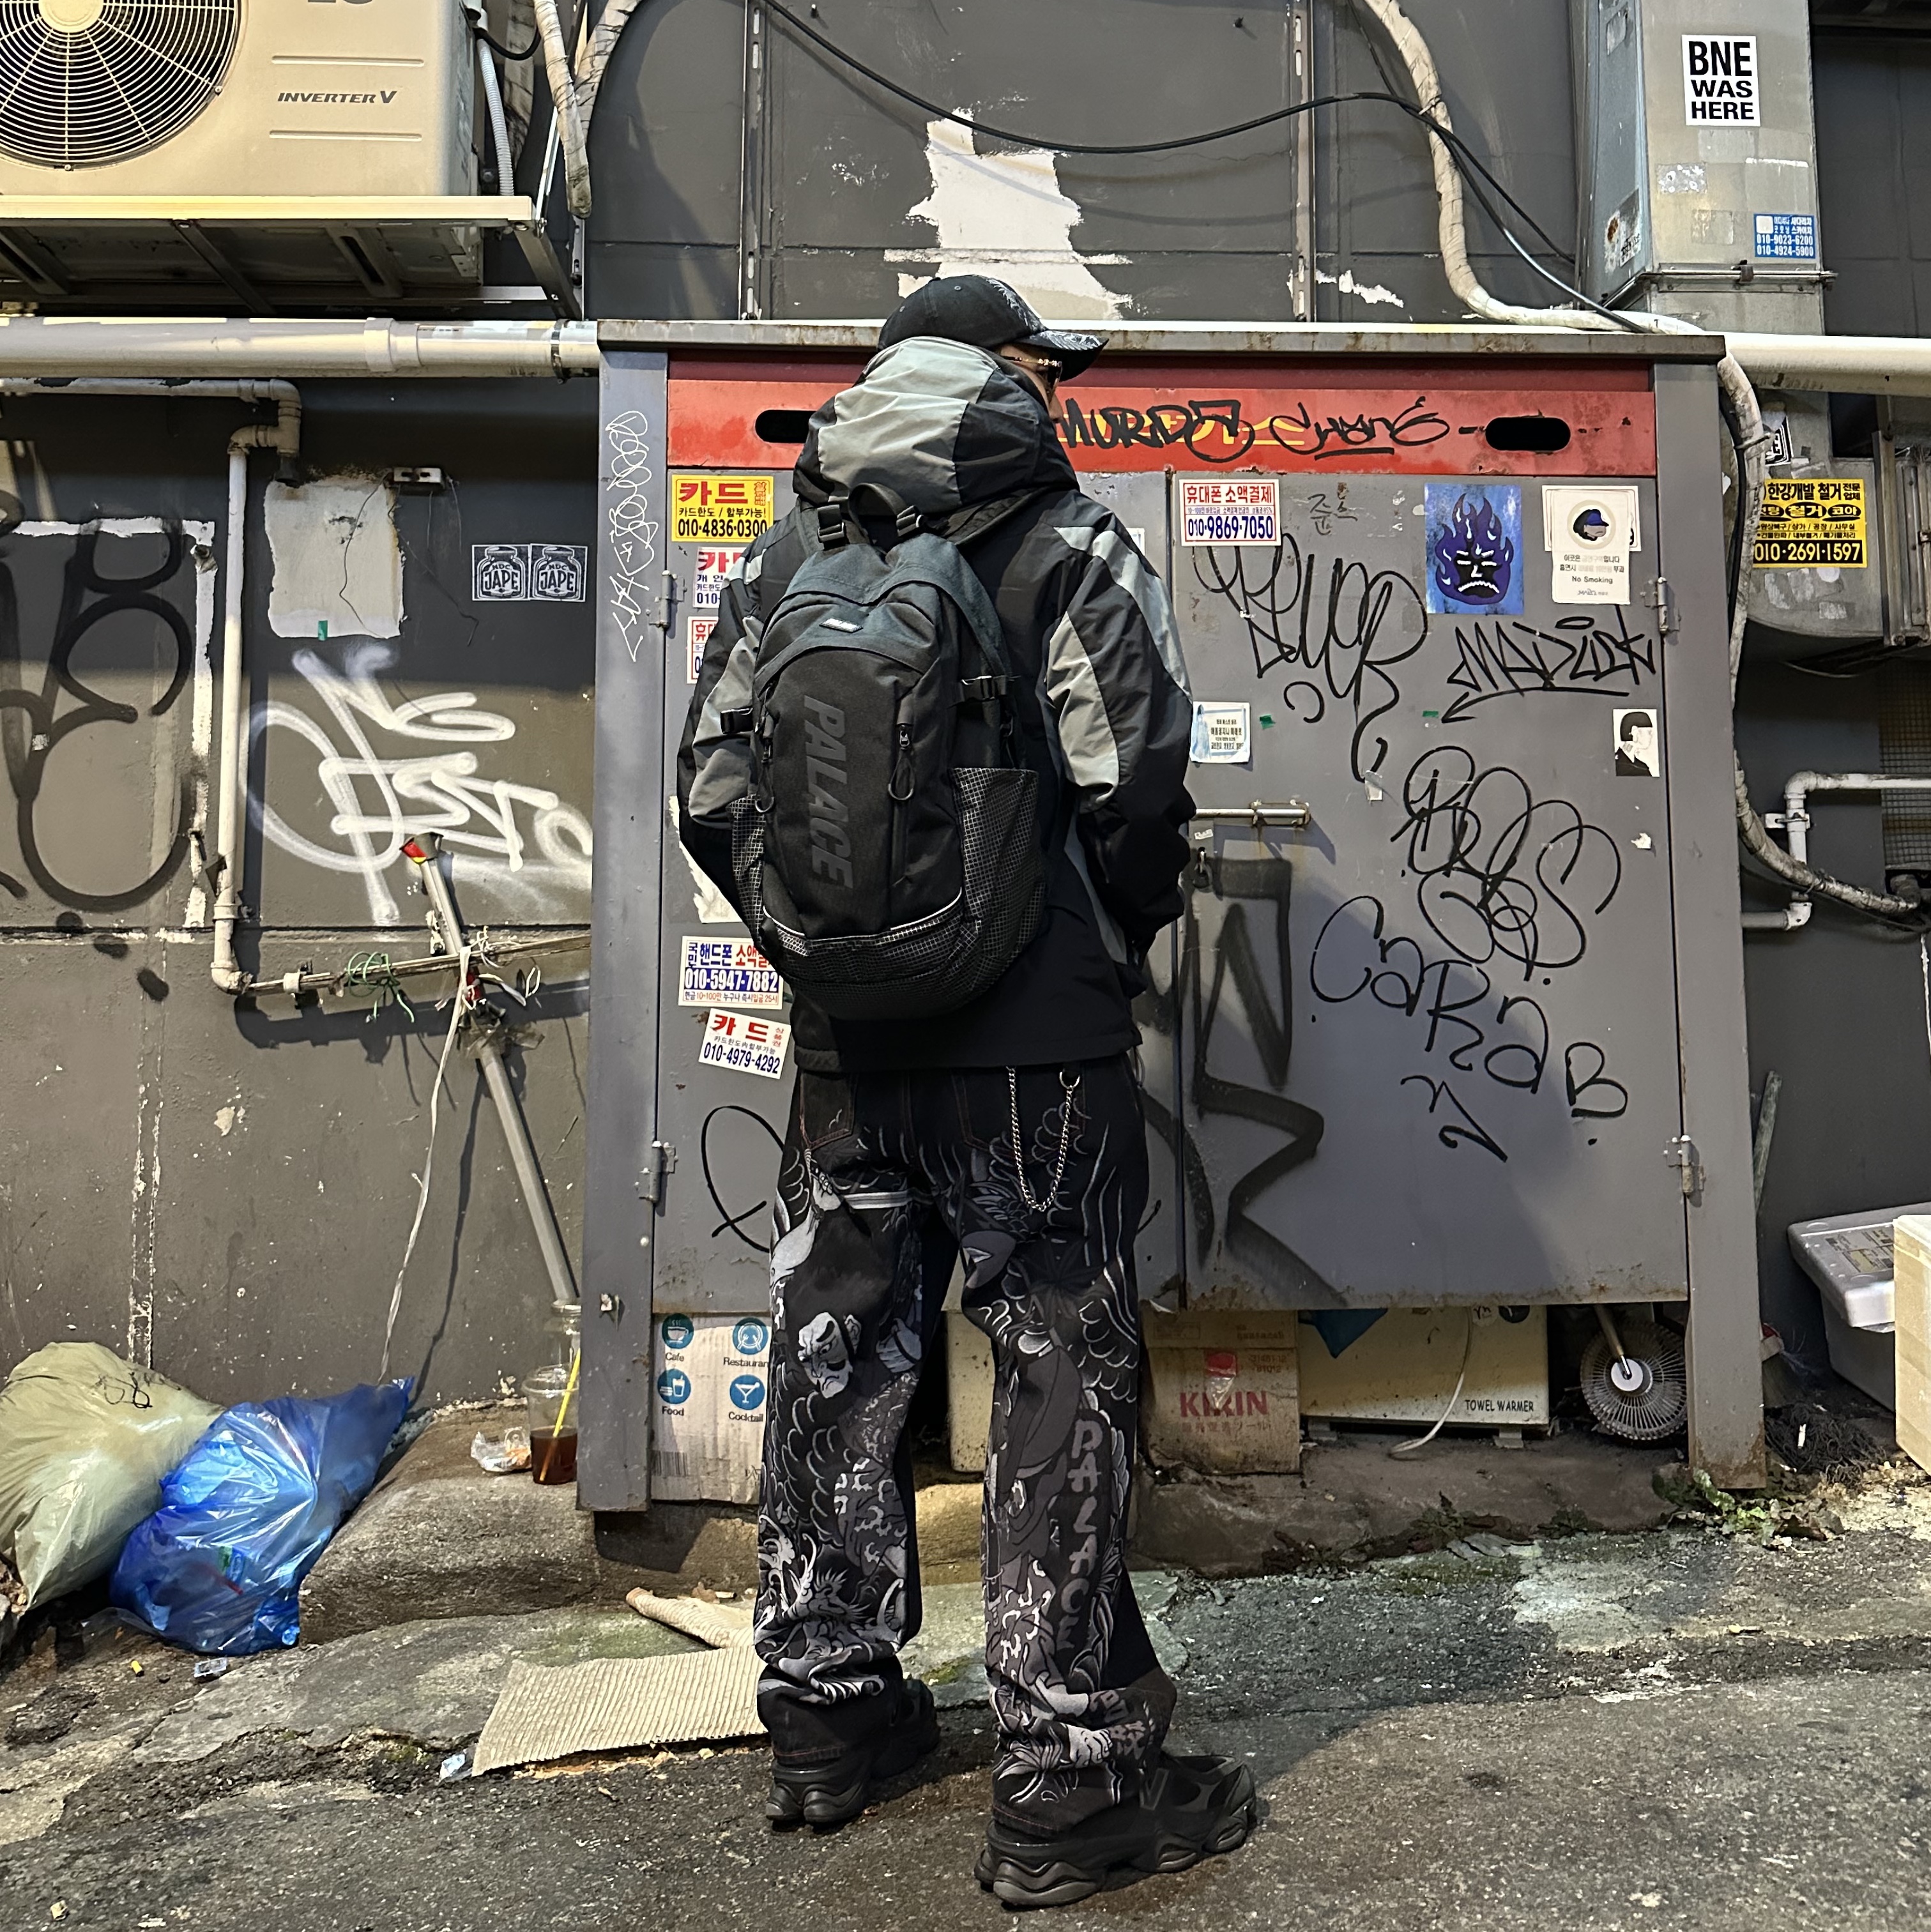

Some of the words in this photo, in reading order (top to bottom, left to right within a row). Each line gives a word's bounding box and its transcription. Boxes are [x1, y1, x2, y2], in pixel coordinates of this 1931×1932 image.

[1688, 41, 1753, 77] BNE
[277, 93, 377, 103] INVERTER
[379, 91, 397, 103] V
[1691, 80, 1753, 98] WAS
[1691, 102, 1755, 119] HERE
[1757, 244, 1814, 256] 010-4924-5900
[678, 482, 748, 505] 카드
[1187, 485, 1221, 503] 휴대폰
[1225, 485, 1272, 503] 소액결제
[1817, 482, 1842, 500] 철거
[679, 507, 715, 517] 카드한도
[1788, 505, 1823, 517] 철거
[1831, 506, 1858, 515] 코아
[698, 551, 743, 573] 카
[1564, 554, 1581, 562] 이곳은
[484, 570, 519, 591] JAPE
[540, 570, 574, 591] JAPE
[1584, 575, 1613, 584] Smoking
[804, 694, 853, 889] PALACE
[700, 943, 733, 966] 핸드폰
[723, 993, 740, 1002] 누구나
[765, 994, 777, 1003] 25시
[703, 1042, 781, 1074] 010-4979-4292
[665, 1352, 685, 1362] Cafe
[662, 1406, 685, 1417] Food
[1465, 1399, 1495, 1411] TOWEL
[1497, 1400, 1534, 1412] WARMER
[728, 1411, 764, 1423] Cocktail
